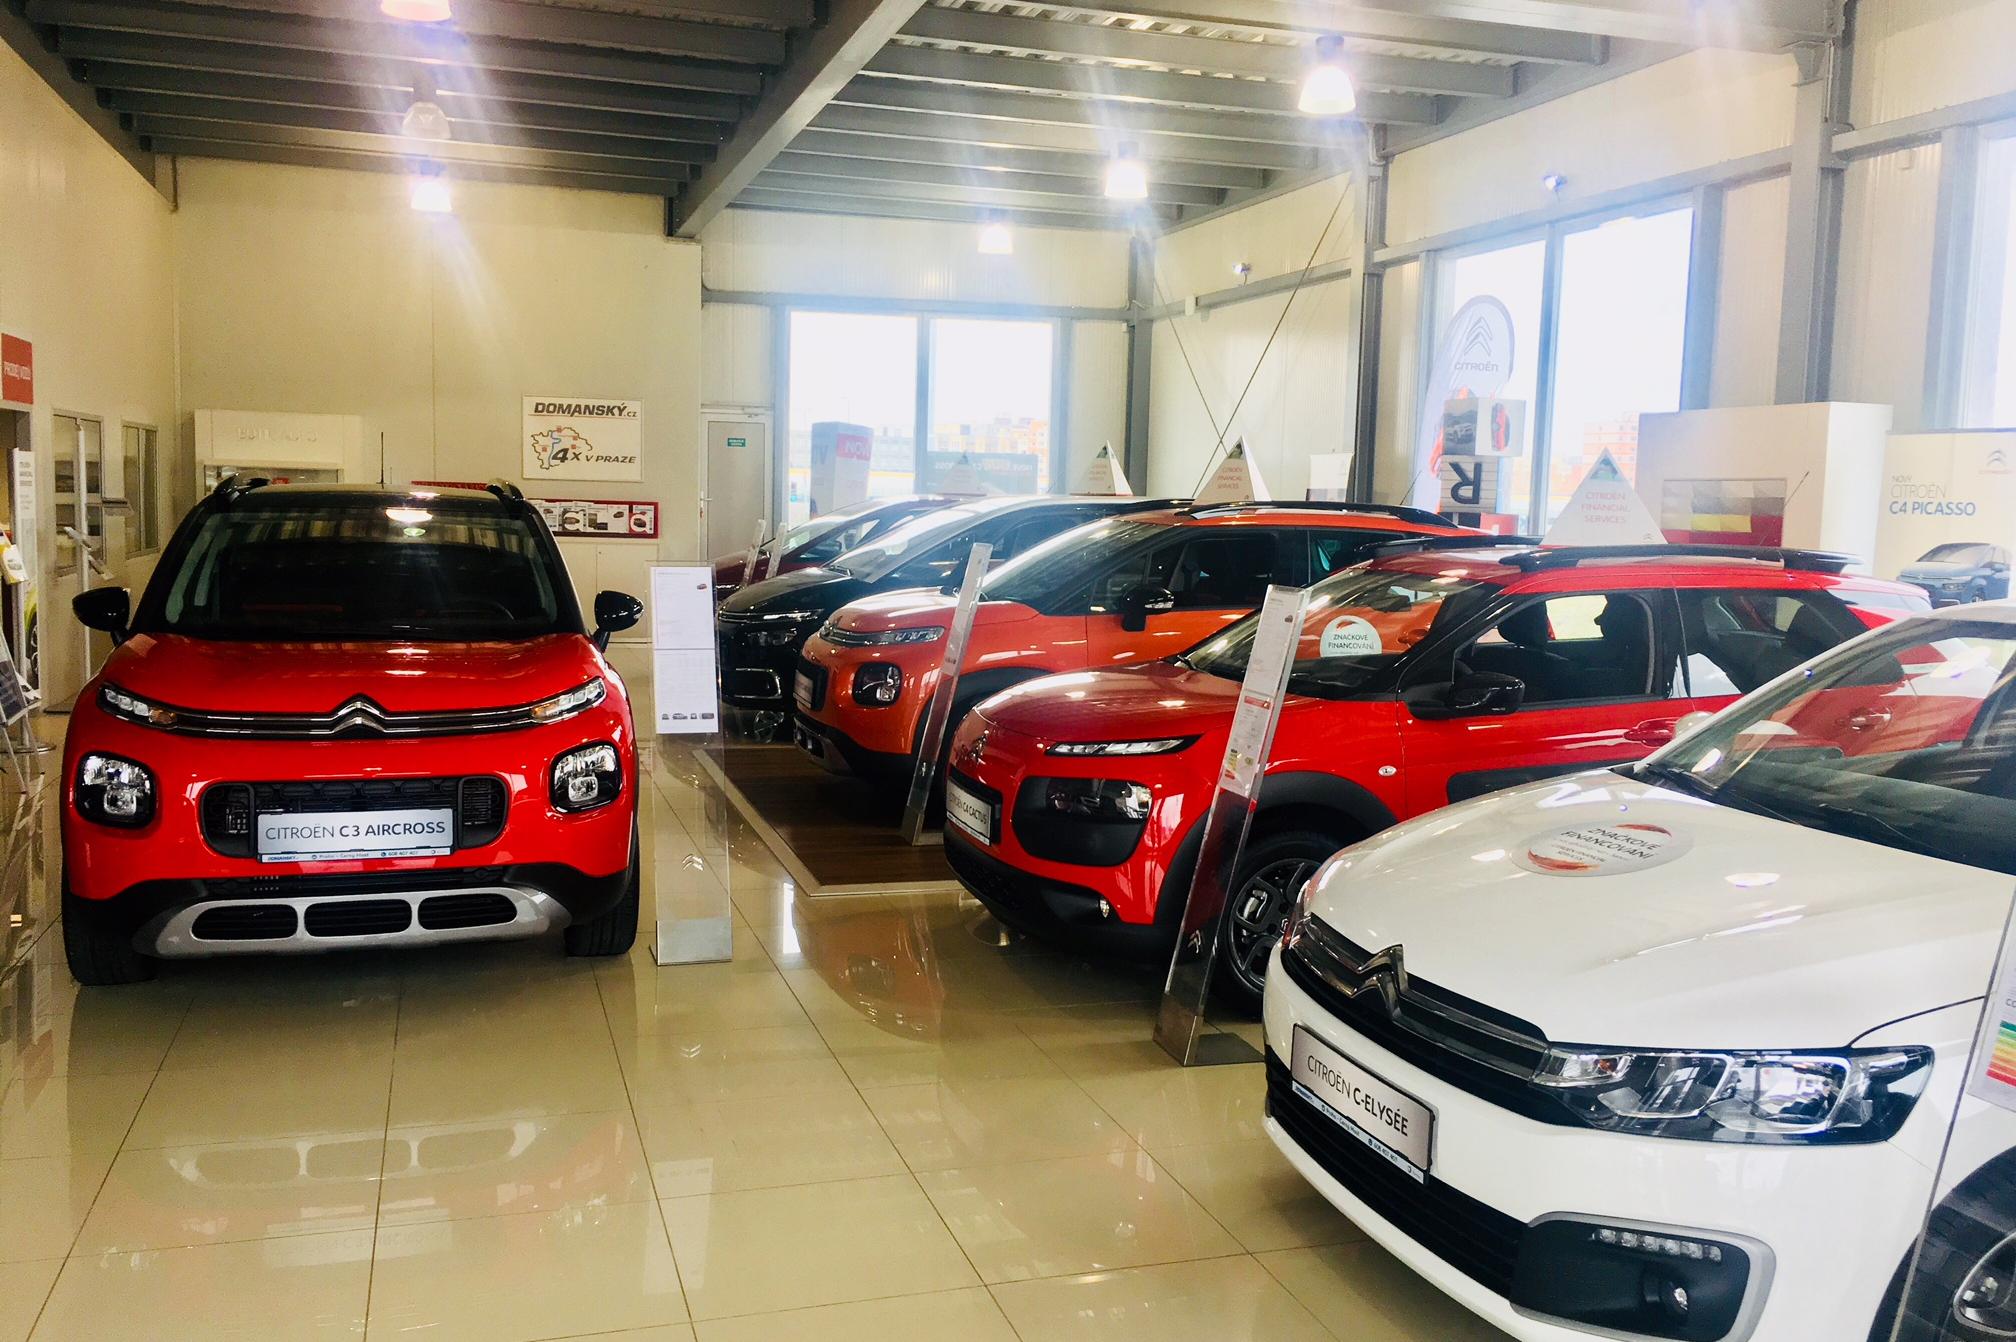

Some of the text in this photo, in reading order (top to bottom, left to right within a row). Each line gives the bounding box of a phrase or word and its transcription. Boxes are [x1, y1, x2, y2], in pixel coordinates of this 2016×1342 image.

[1454, 360, 1499, 372] CITROËN
[595, 455, 637, 464] PRAZE
[1890, 483, 1947, 499] CITROËN
[1581, 503, 1631, 512] FINANCIAL
[1889, 501, 1977, 516] C4 PICASSO
[1585, 515, 1626, 524] SERVICES
[969, 805, 988, 825] CACTUS
[265, 821, 446, 840] CITROËN C3 AIRCROSS
[1307, 1055, 1408, 1137] CITROËN C-ELYSÉE
